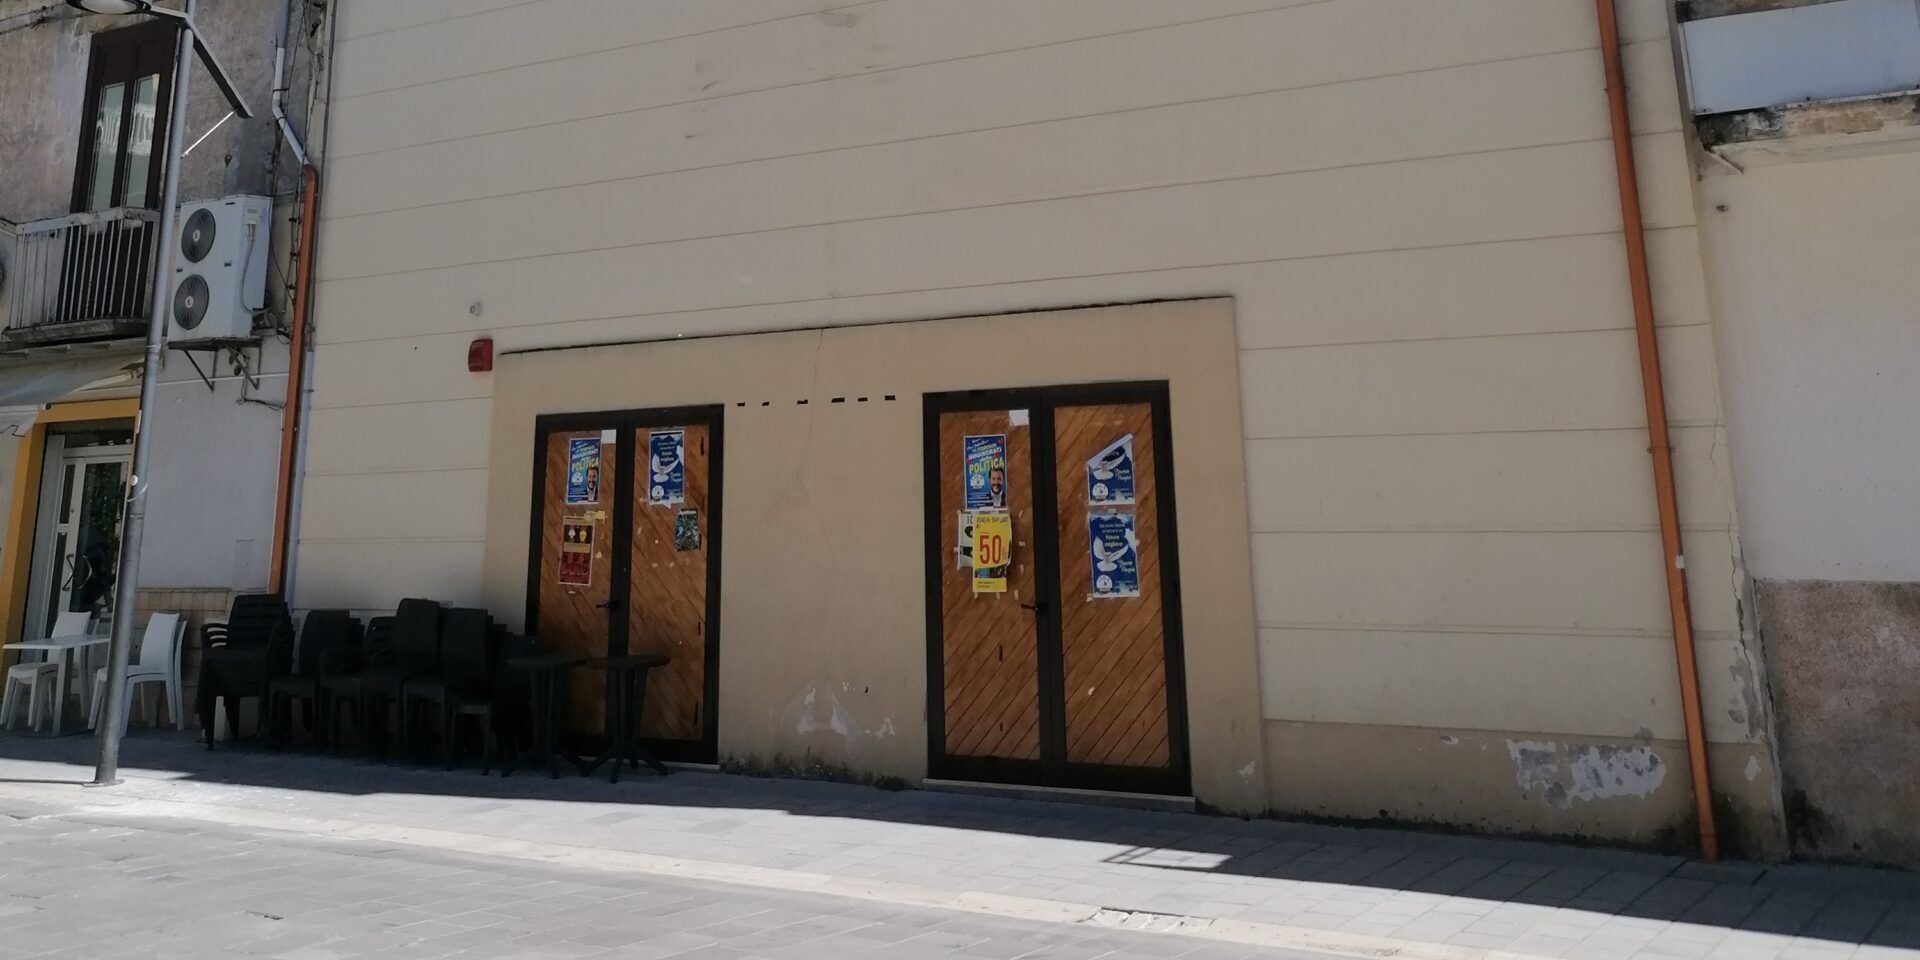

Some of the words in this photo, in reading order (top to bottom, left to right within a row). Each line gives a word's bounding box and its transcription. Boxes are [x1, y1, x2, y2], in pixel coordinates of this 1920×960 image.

[571, 457, 599, 472] POLITICA
[969, 457, 1005, 474] POLITICA
[979, 534, 1002, 564] 50
